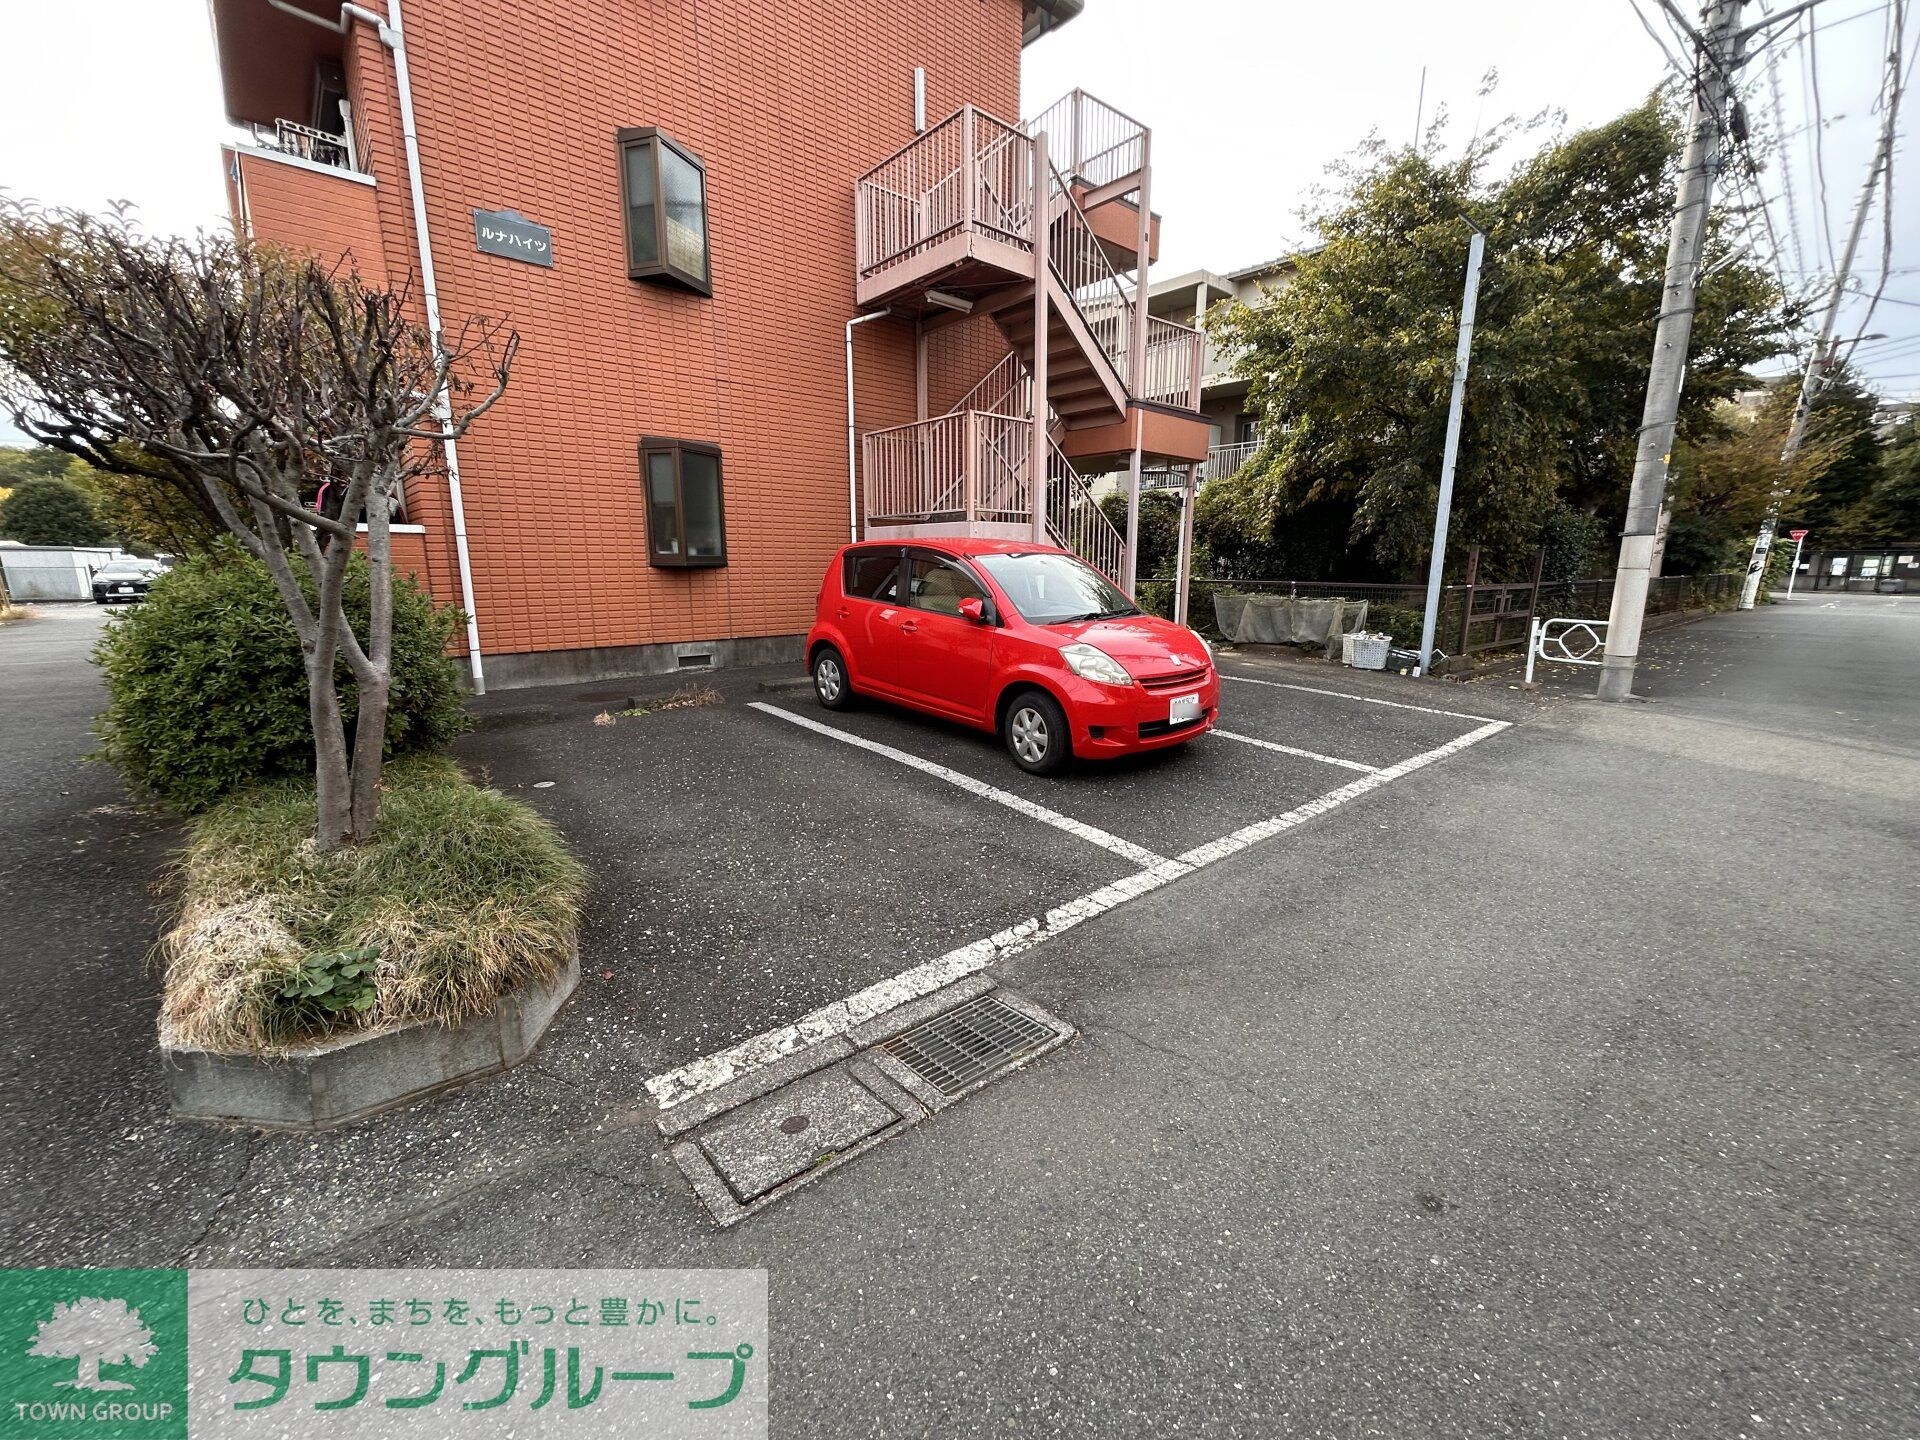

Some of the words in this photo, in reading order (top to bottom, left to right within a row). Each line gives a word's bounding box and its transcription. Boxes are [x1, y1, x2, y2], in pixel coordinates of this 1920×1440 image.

[481, 227, 547, 252] ルナハイツ
